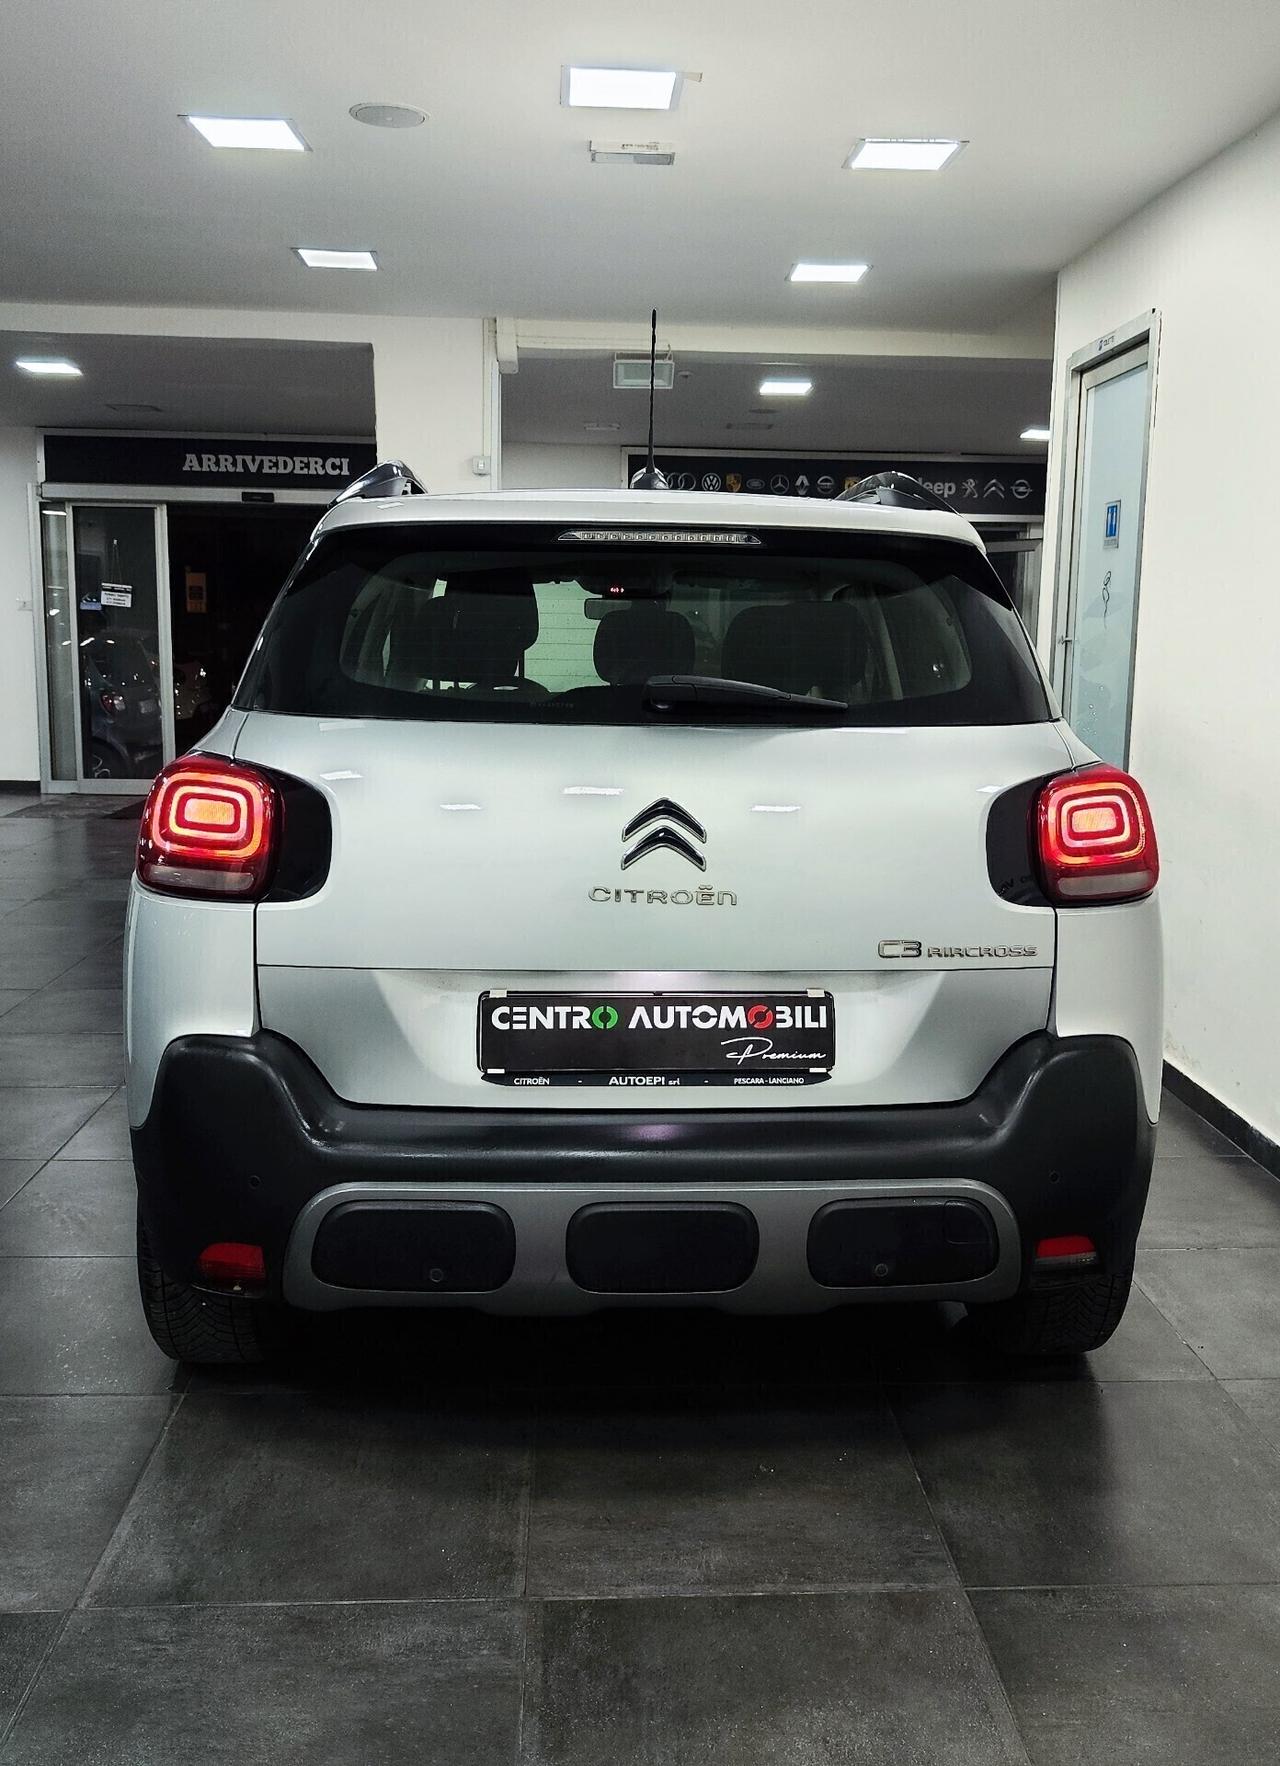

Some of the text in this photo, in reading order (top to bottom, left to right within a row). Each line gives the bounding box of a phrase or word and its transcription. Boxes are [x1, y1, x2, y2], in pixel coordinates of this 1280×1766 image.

[182, 453, 350, 476] ARRIVEDERCI
[877, 939, 1038, 959] C3 AIRCROSS
[491, 1004, 827, 1031] CENTRO AUTOMOBILI
[720, 1035, 827, 1066] Premium
[513, 1075, 550, 1086] CITROËN
[608, 1075, 666, 1086] AUTOEPI
